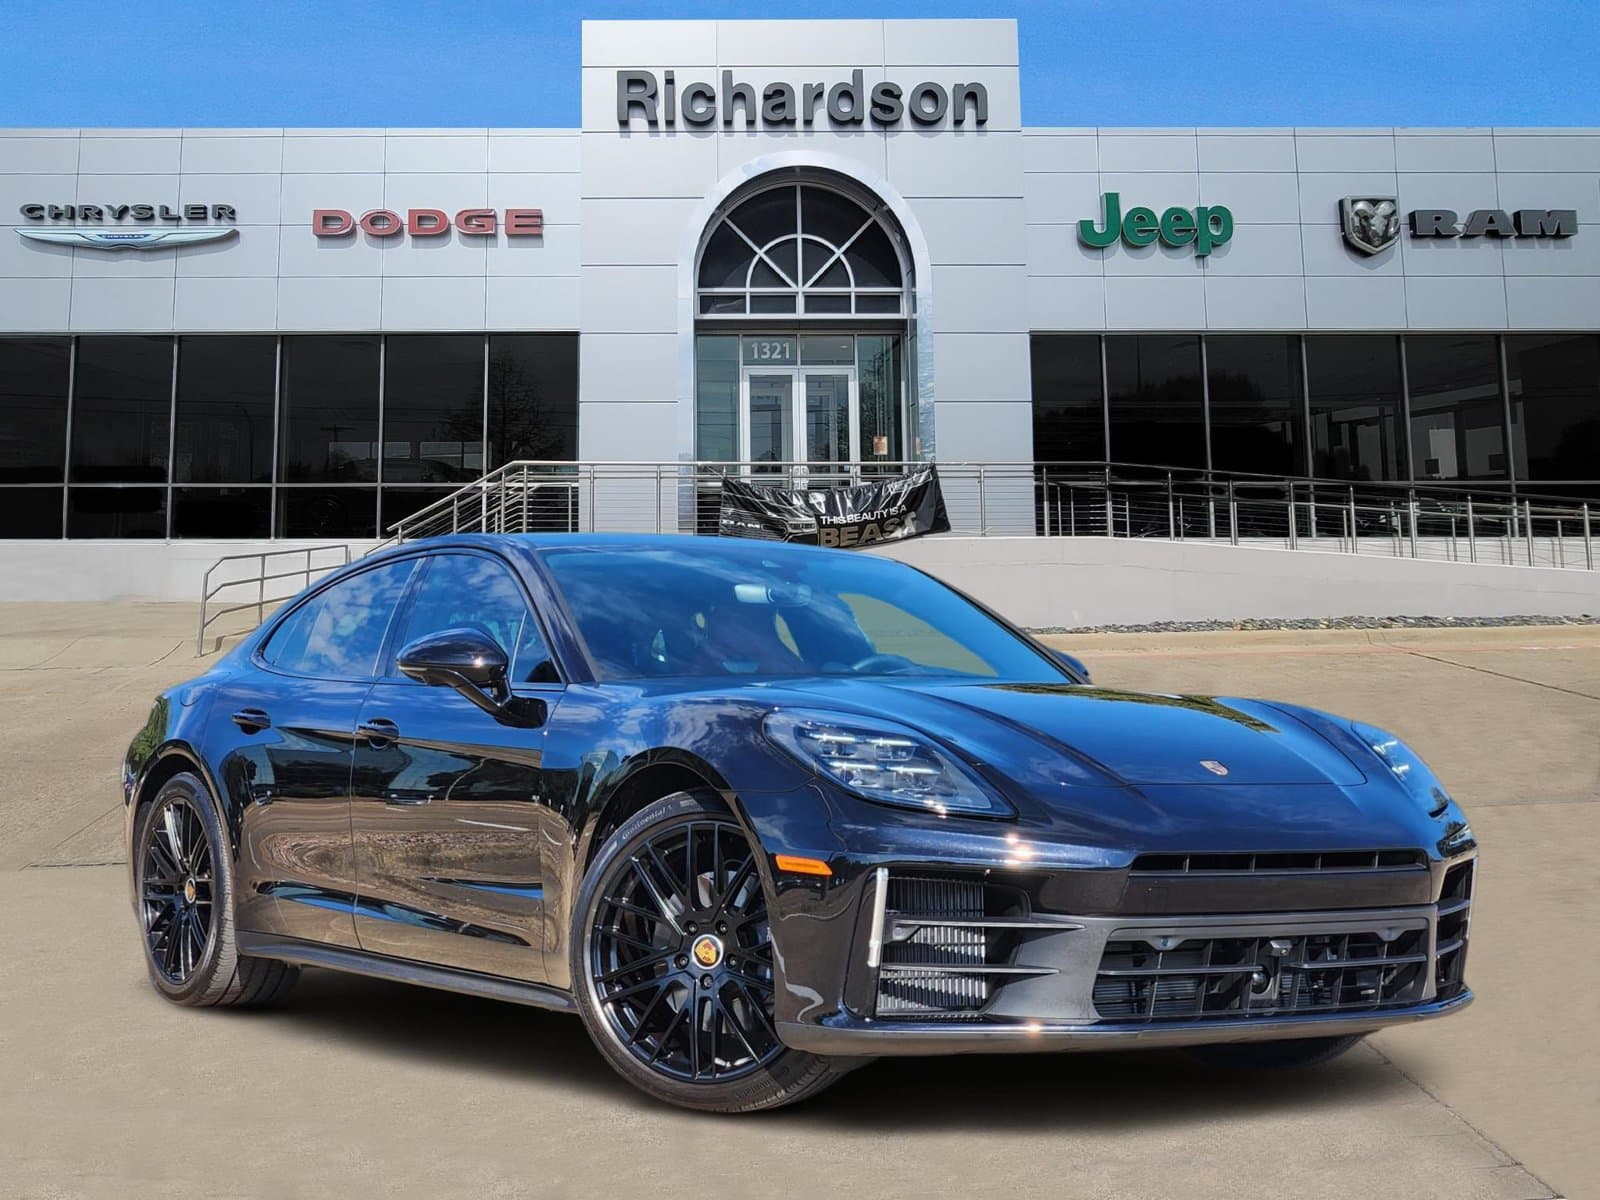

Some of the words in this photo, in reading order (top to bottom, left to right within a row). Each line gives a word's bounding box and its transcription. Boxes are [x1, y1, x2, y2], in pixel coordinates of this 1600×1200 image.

[616, 69, 989, 127] Richardson
[20, 203, 237, 221] CHRYSLER
[312, 208, 544, 237] DODGE
[1077, 192, 1234, 257] Jeep
[1408, 209, 1579, 238] RAM
[751, 342, 791, 359] 1321
[820, 515, 846, 525] THIS
[846, 508, 888, 523] BEAUTY
[889, 506, 899, 516] IS
[899, 504, 907, 513] A
[820, 511, 917, 547] BEAST
